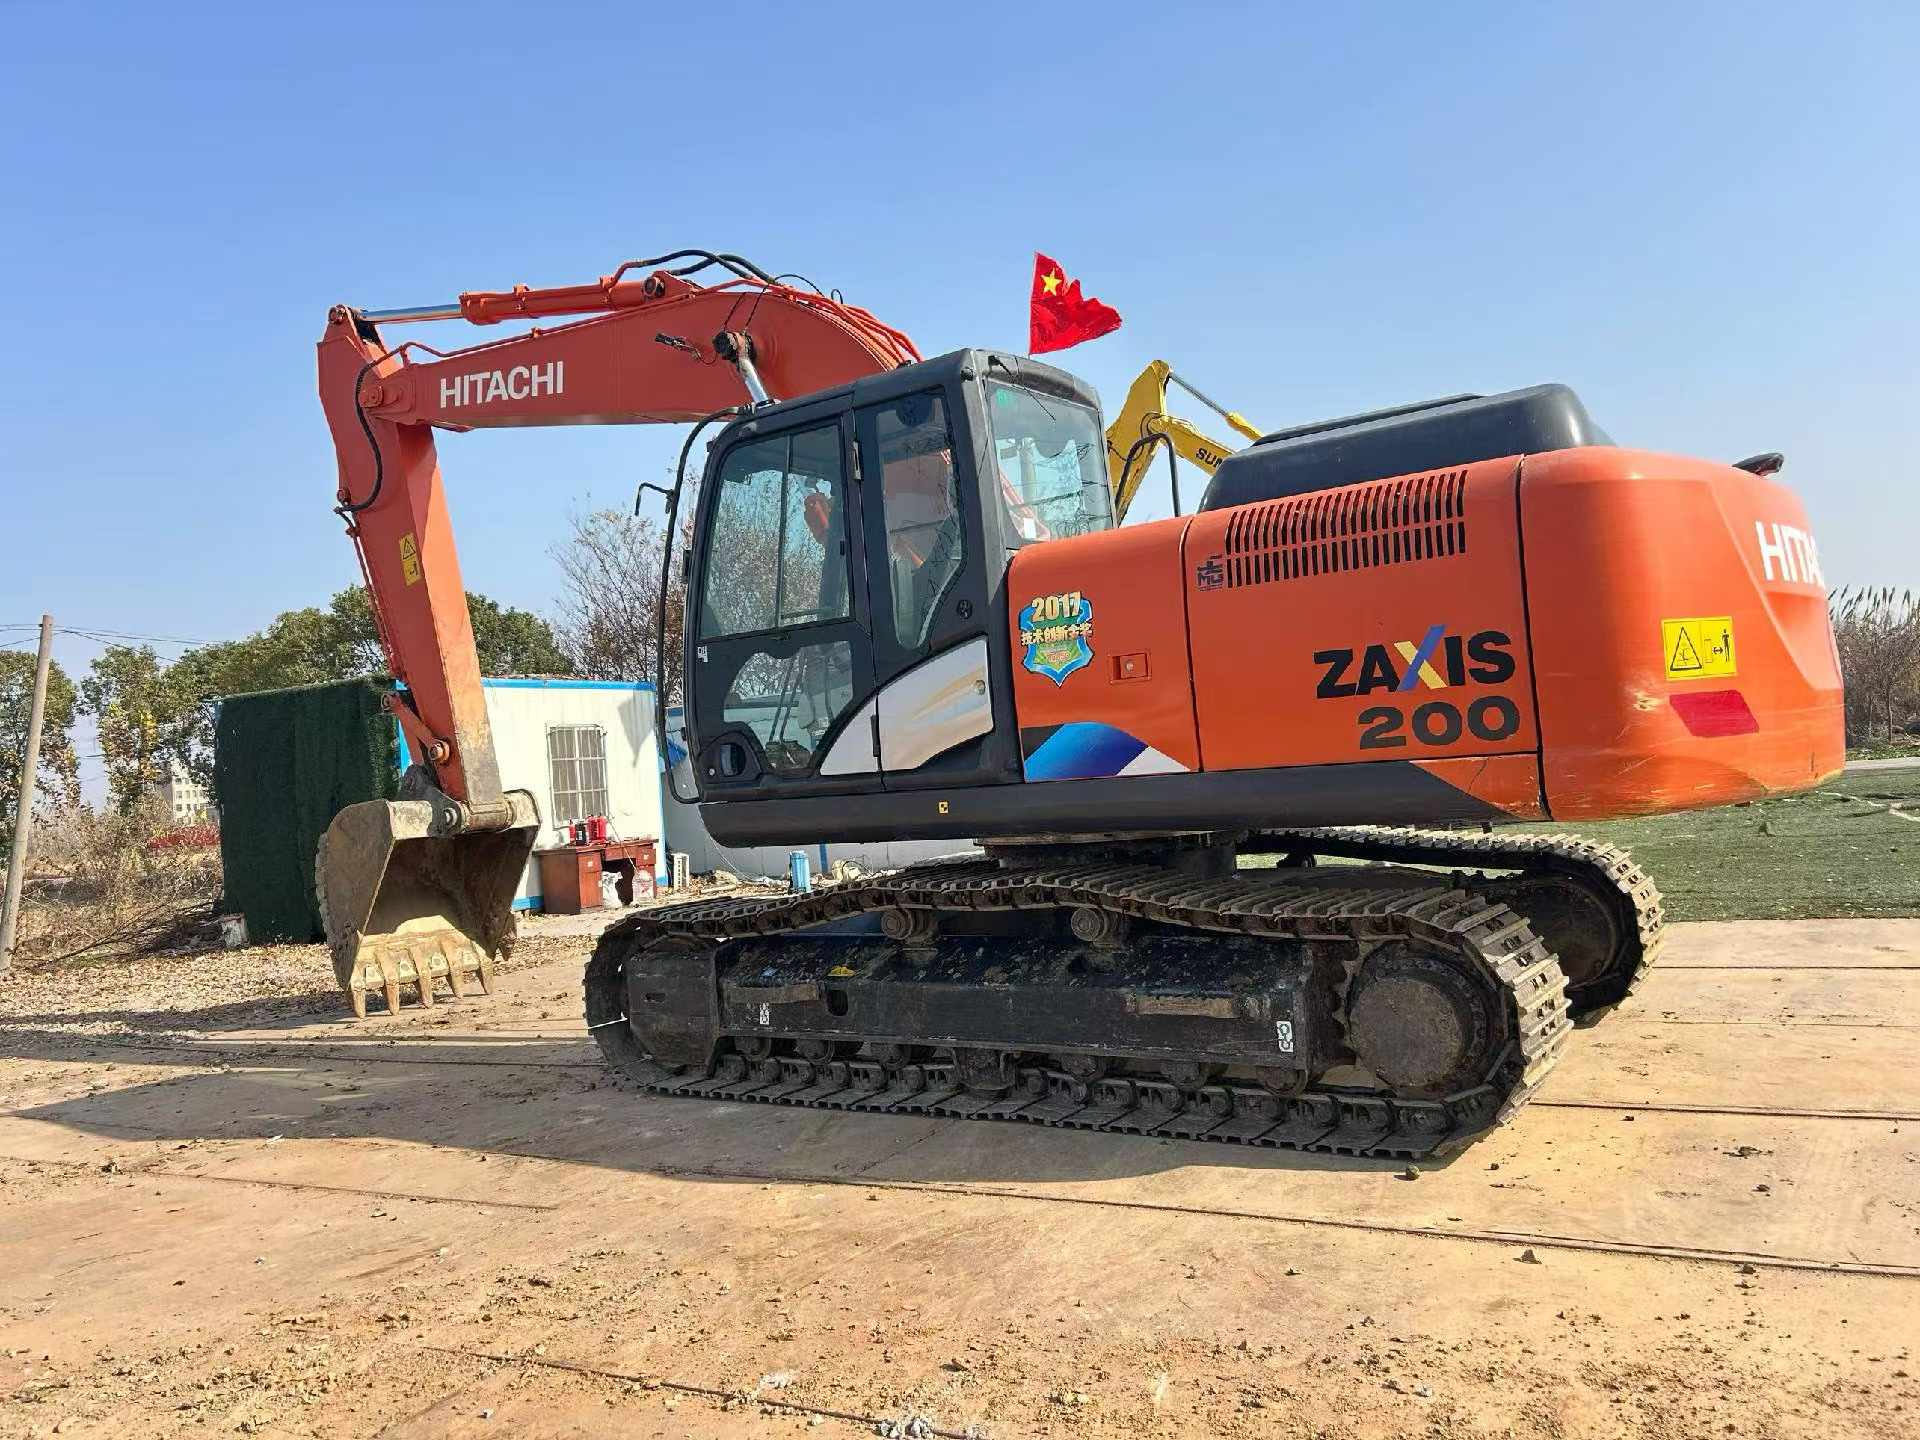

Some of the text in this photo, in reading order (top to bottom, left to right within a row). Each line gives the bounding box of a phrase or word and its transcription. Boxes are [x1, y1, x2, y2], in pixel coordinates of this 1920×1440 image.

[440, 361, 564, 408] HITACHI
[1031, 591, 1082, 621] 2017
[1313, 624, 1515, 698] ZAXIS
[1358, 696, 1520, 749] 200
